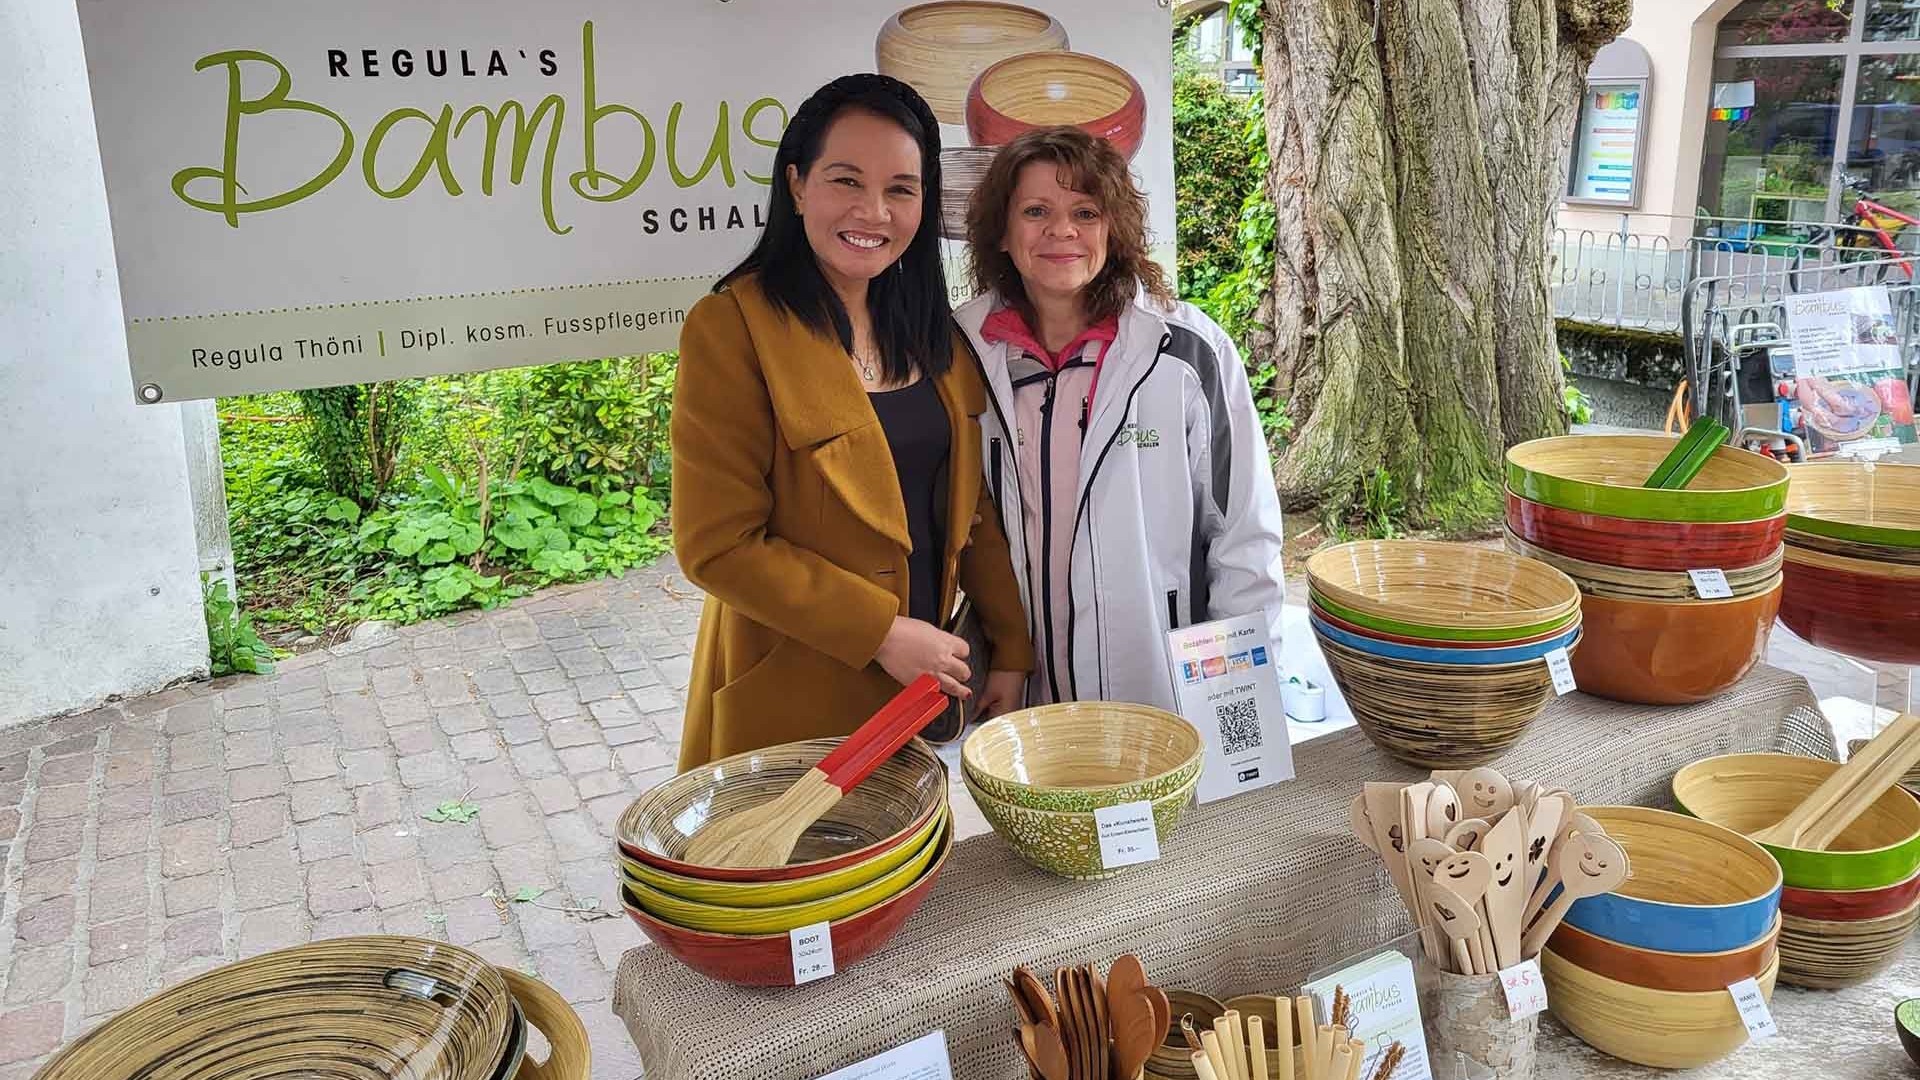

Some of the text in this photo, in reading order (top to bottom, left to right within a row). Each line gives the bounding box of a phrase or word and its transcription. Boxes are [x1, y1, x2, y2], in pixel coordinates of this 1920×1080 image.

[171, 20, 792, 235] Bambus
[642, 204, 766, 235] SCHAL
[191, 307, 686, 370] Regula Thöni Dipl. kosm. Fusspflegerin
[1234, 683, 1257, 696] TWINT
[798, 935, 820, 946] BOOT
[798, 967, 809, 976] Fr.
